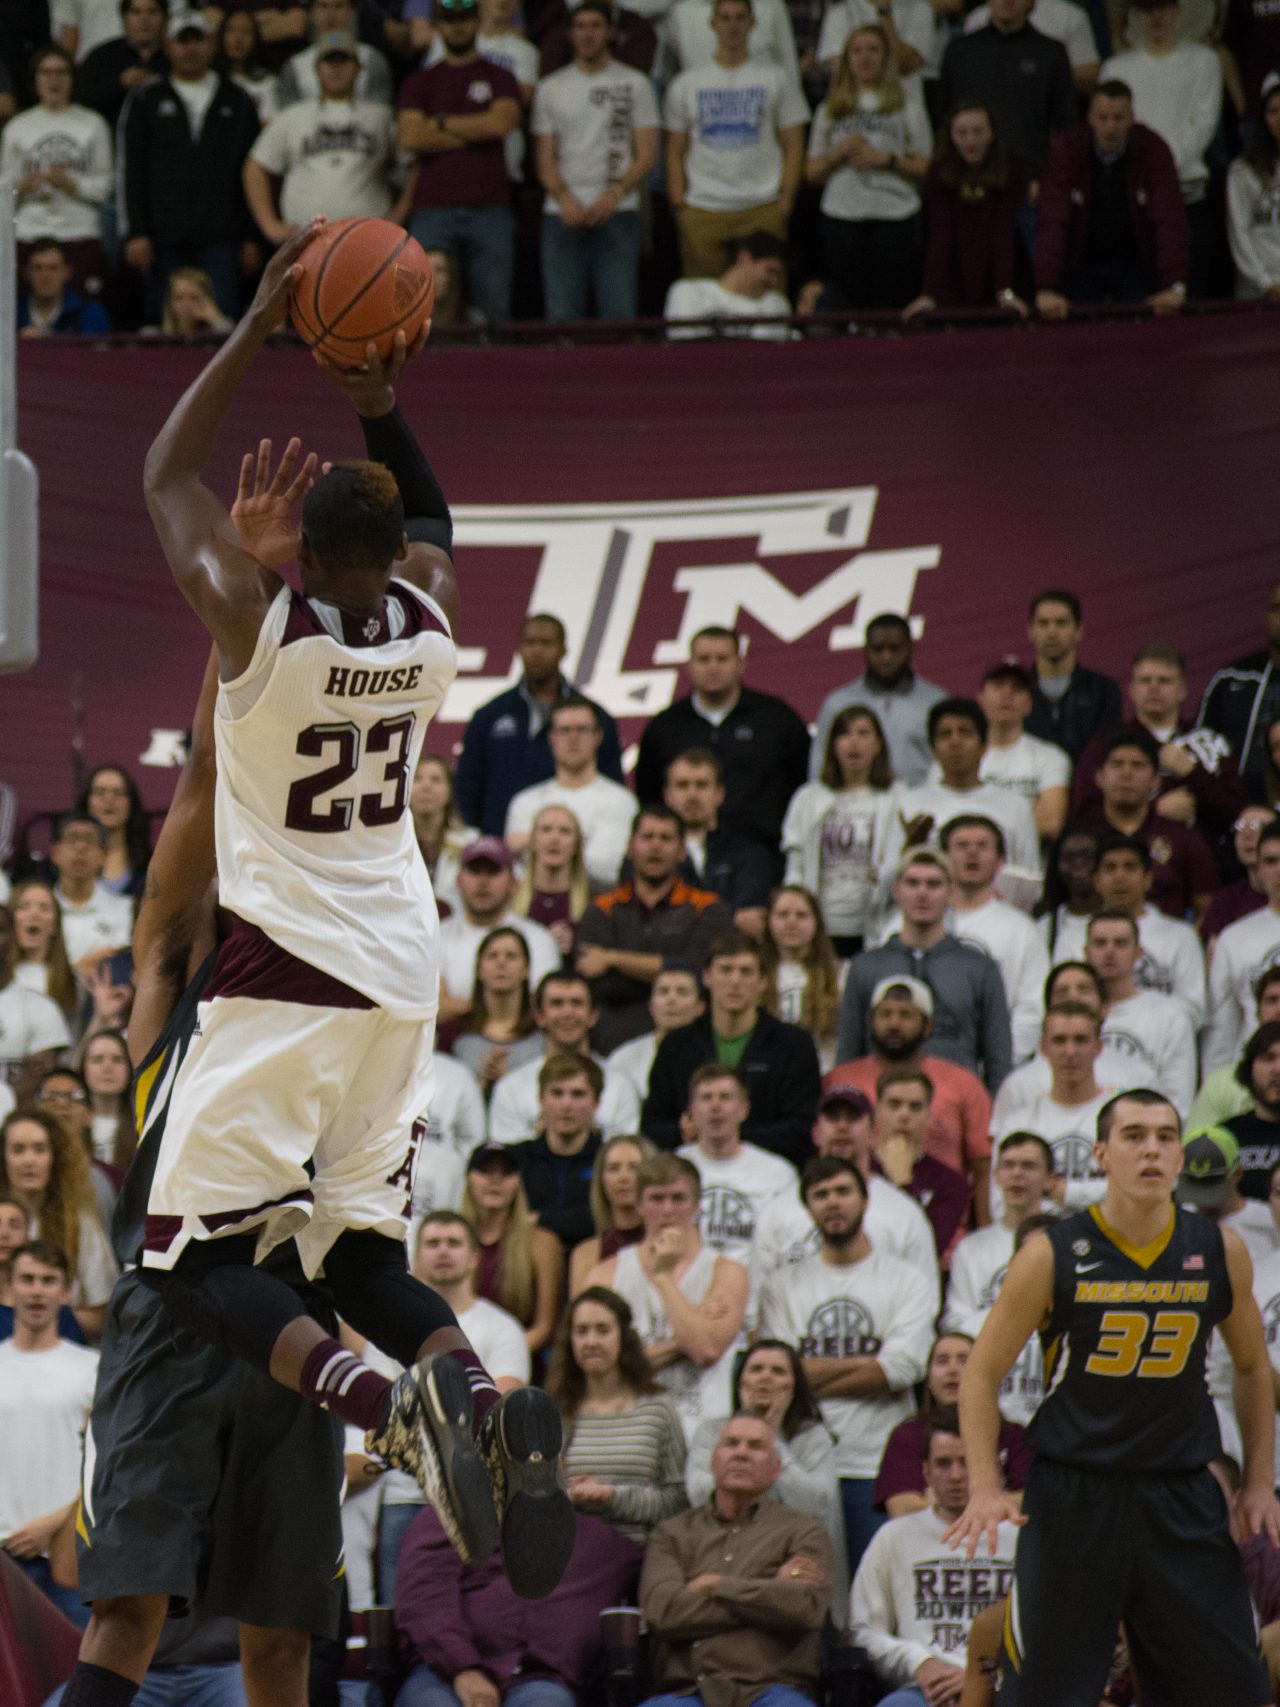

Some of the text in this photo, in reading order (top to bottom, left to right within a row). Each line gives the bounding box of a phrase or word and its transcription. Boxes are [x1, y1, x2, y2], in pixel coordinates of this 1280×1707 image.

[325, 665, 423, 697] HOUSE
[285, 711, 417, 832] 23
[1074, 1280, 1210, 1303] MISSOURI
[799, 1336, 881, 1358] REED
[1084, 1310, 1201, 1379] 33
